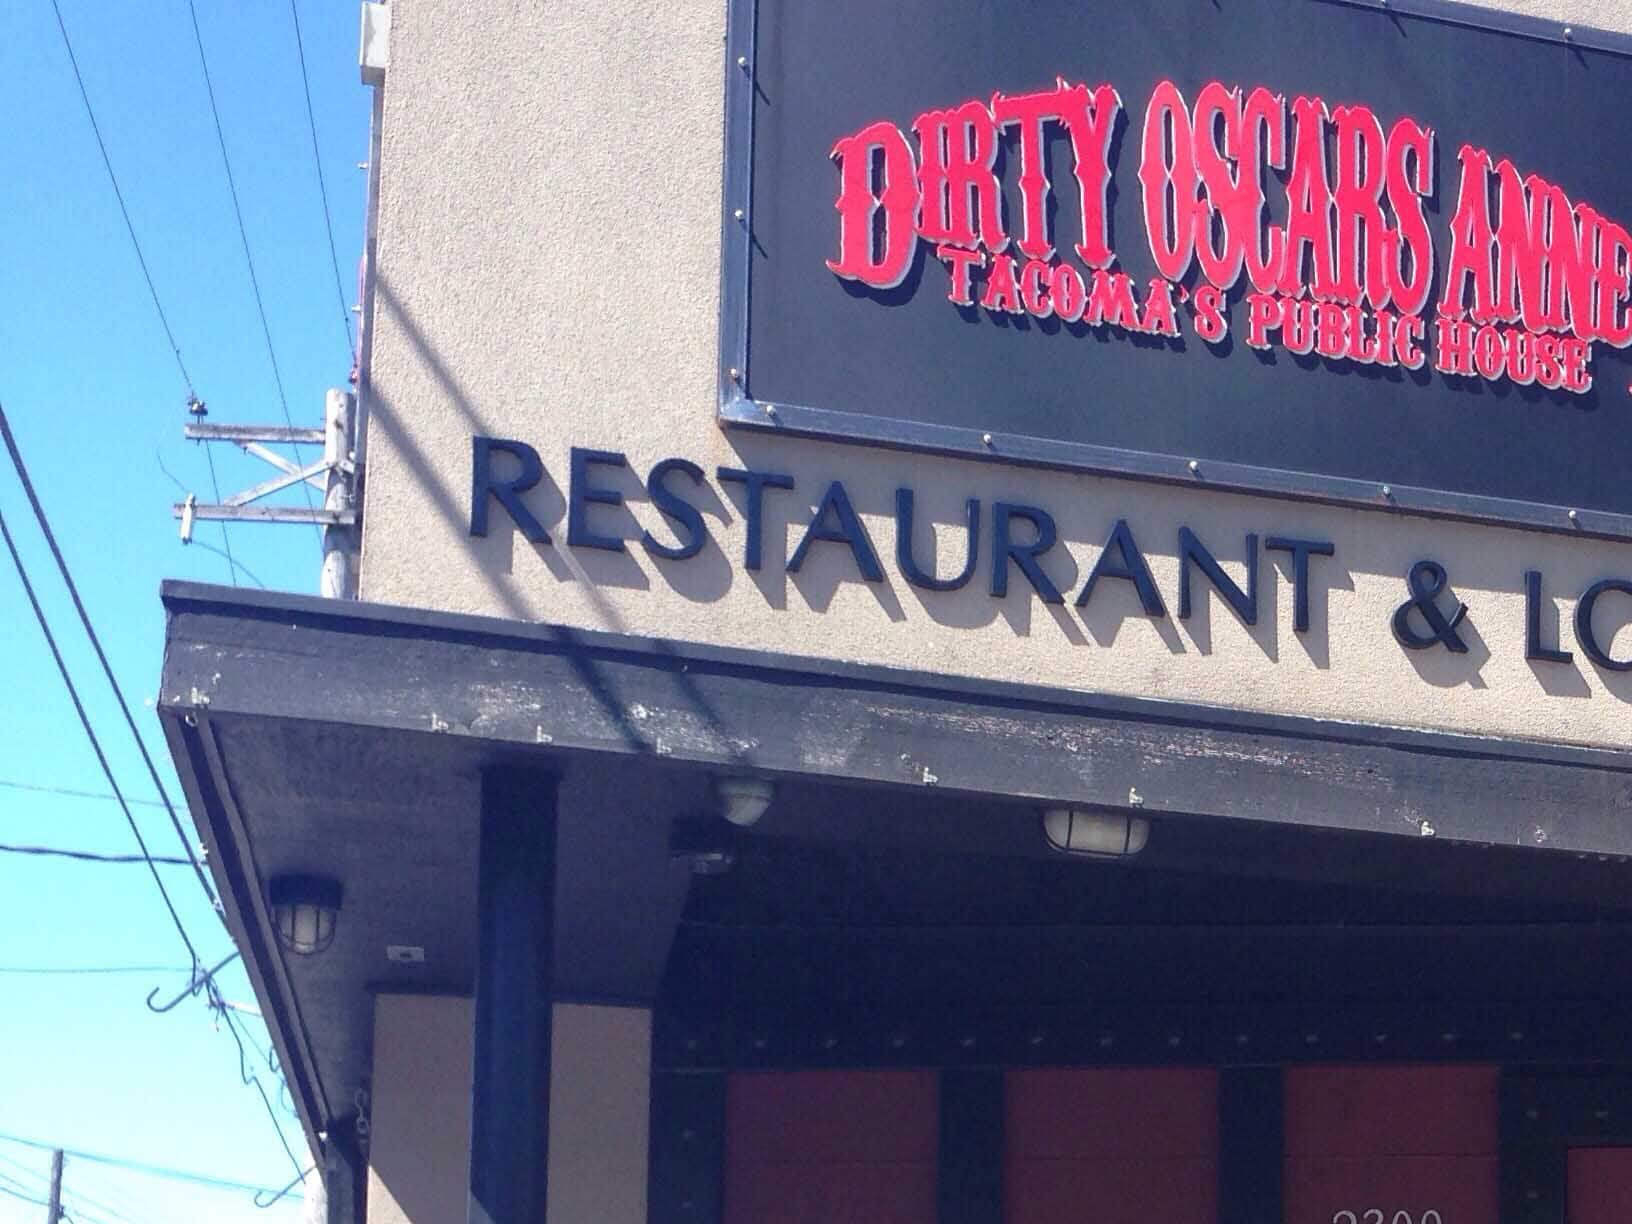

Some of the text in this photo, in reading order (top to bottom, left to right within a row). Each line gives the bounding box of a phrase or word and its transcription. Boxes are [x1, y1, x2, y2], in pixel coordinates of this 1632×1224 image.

[824, 75, 1122, 290] DIRTY
[1138, 80, 1437, 317] OSCARS
[937, 243, 1593, 394] TACOMA'S PUBLIC HOUSE
[470, 435, 1335, 633] RESTAURANT
[1392, 560, 1468, 653] &
